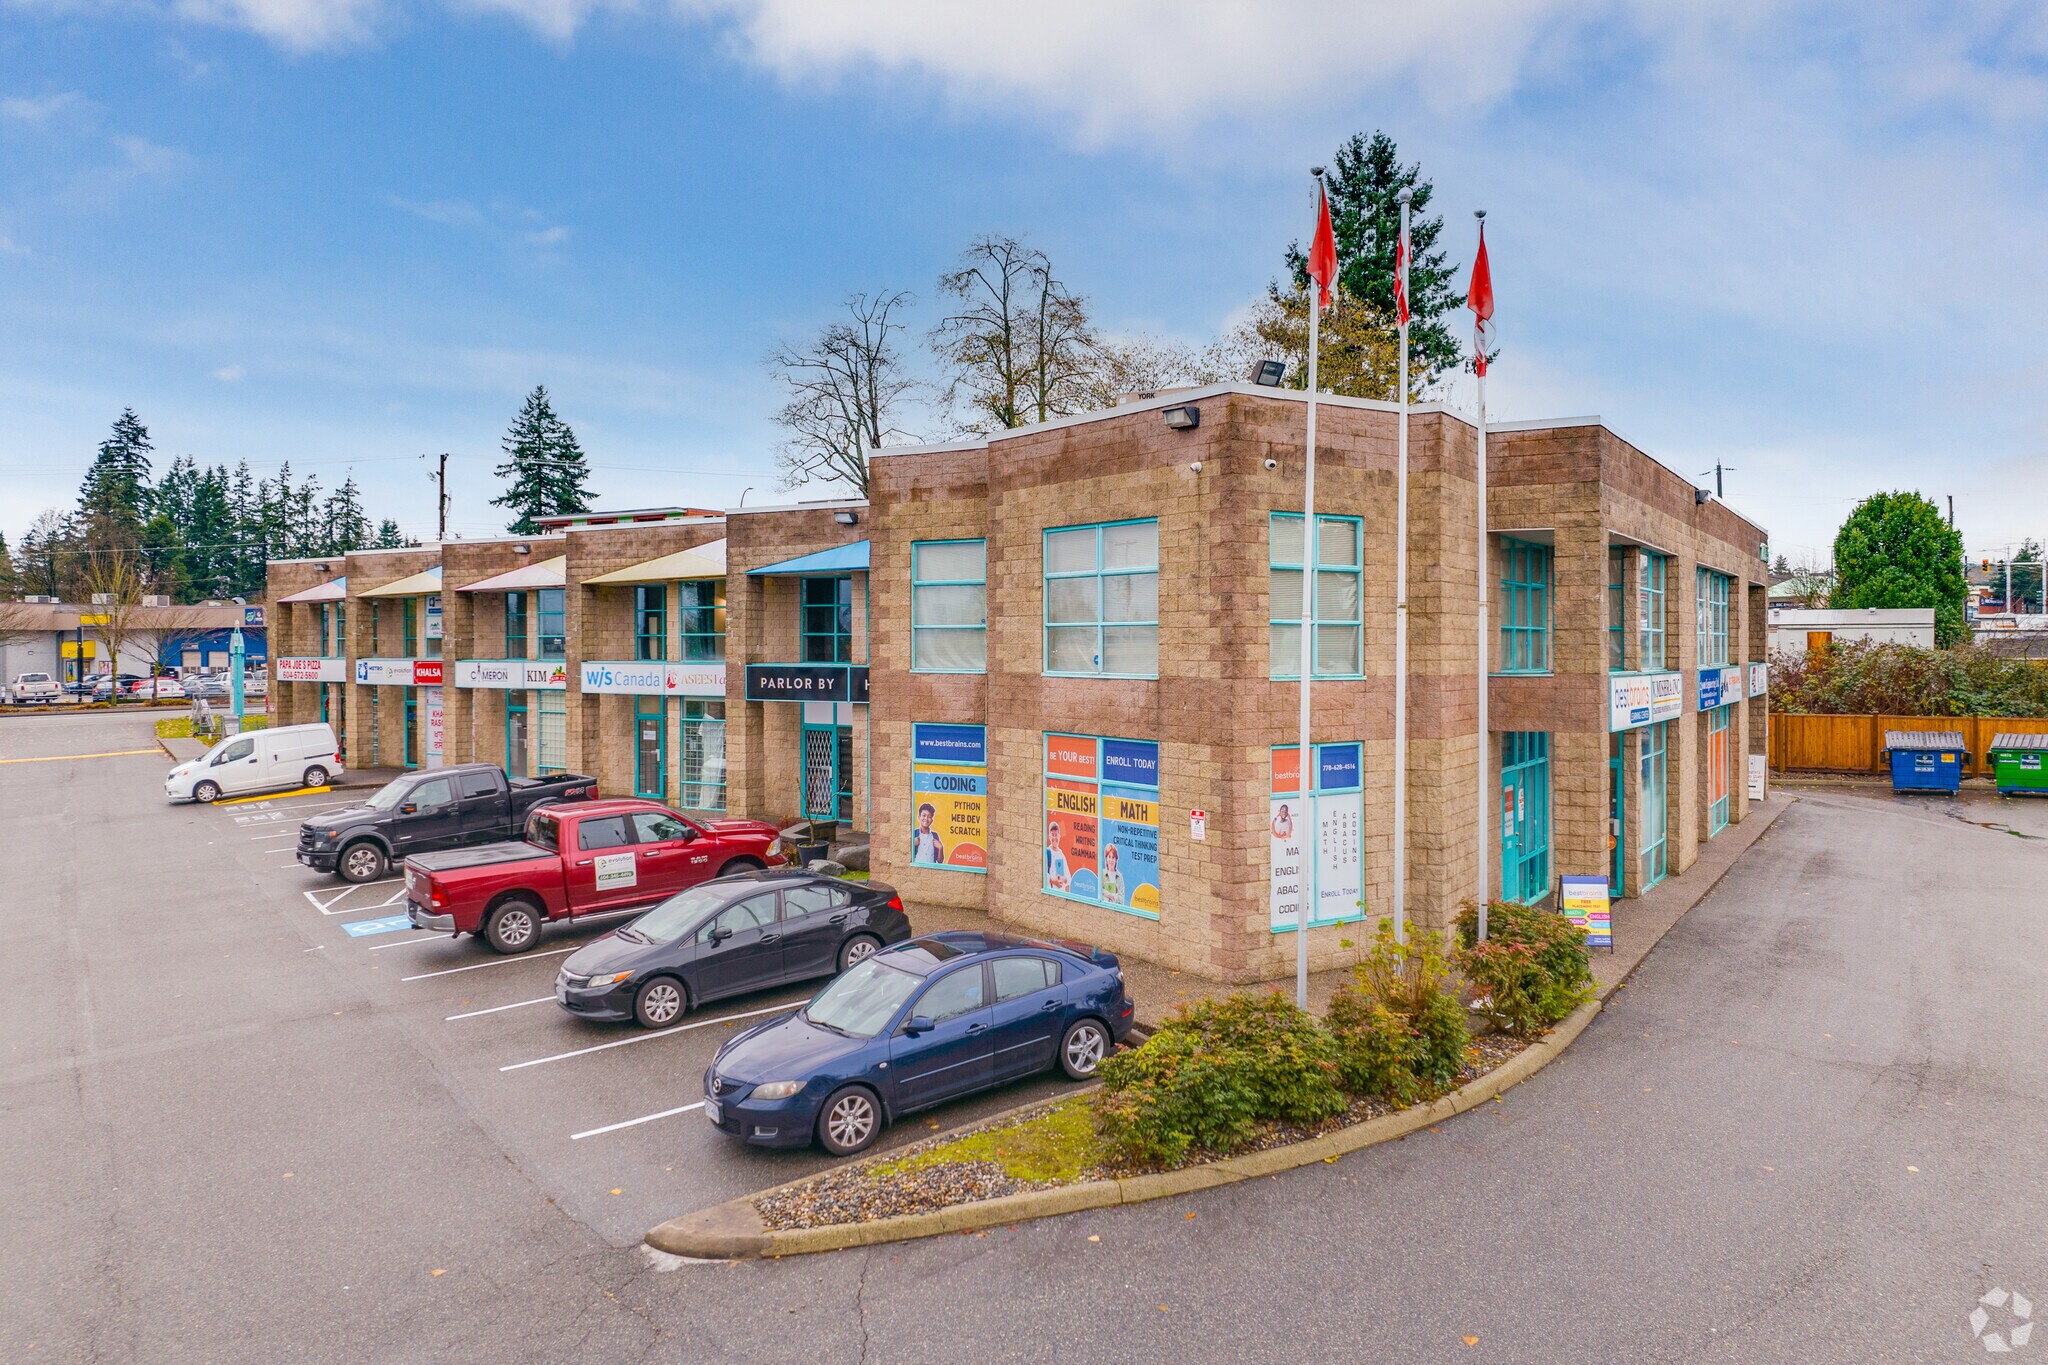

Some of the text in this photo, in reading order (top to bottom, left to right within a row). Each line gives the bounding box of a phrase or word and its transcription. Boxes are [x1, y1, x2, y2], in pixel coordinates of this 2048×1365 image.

[280, 660, 291, 669] PAPA
[307, 661, 321, 670] PIZZA
[416, 668, 441, 677] KHALSA
[527, 670, 547, 682] KIM
[615, 672, 660, 686] Canada
[760, 678, 835, 690] PARLOR BY
[920, 740, 981, 748] www.bestbrains.com
[1050, 750, 1095, 765] BE YOUR BEST!
[1106, 756, 1156, 770] ENROLL TODAY
[1274, 771, 1300, 779] bestbra
[934, 776, 976, 792] CODING
[954, 801, 980, 811] PYTHON
[1057, 793, 1096, 813] ENGLISH
[1120, 801, 1148, 821] MATH
[951, 814, 980, 824] WEB DEV
[950, 826, 980, 836] SCRATCH
[1073, 822, 1096, 834] READING
[1118, 825, 1157, 839] NON-REPETITIVE
[1075, 836, 1095, 847] WRITING
[1113, 836, 1157, 851] CRITICAL THINKING
[1071, 847, 1096, 860] GRAMMAR
[1132, 851, 1157, 864] TEST PREP
[1286, 847, 1300, 856] MA
[1275, 866, 1300, 876] ENGLI
[1276, 884, 1309, 895] ABAC
[1279, 902, 1309, 914] CODI
